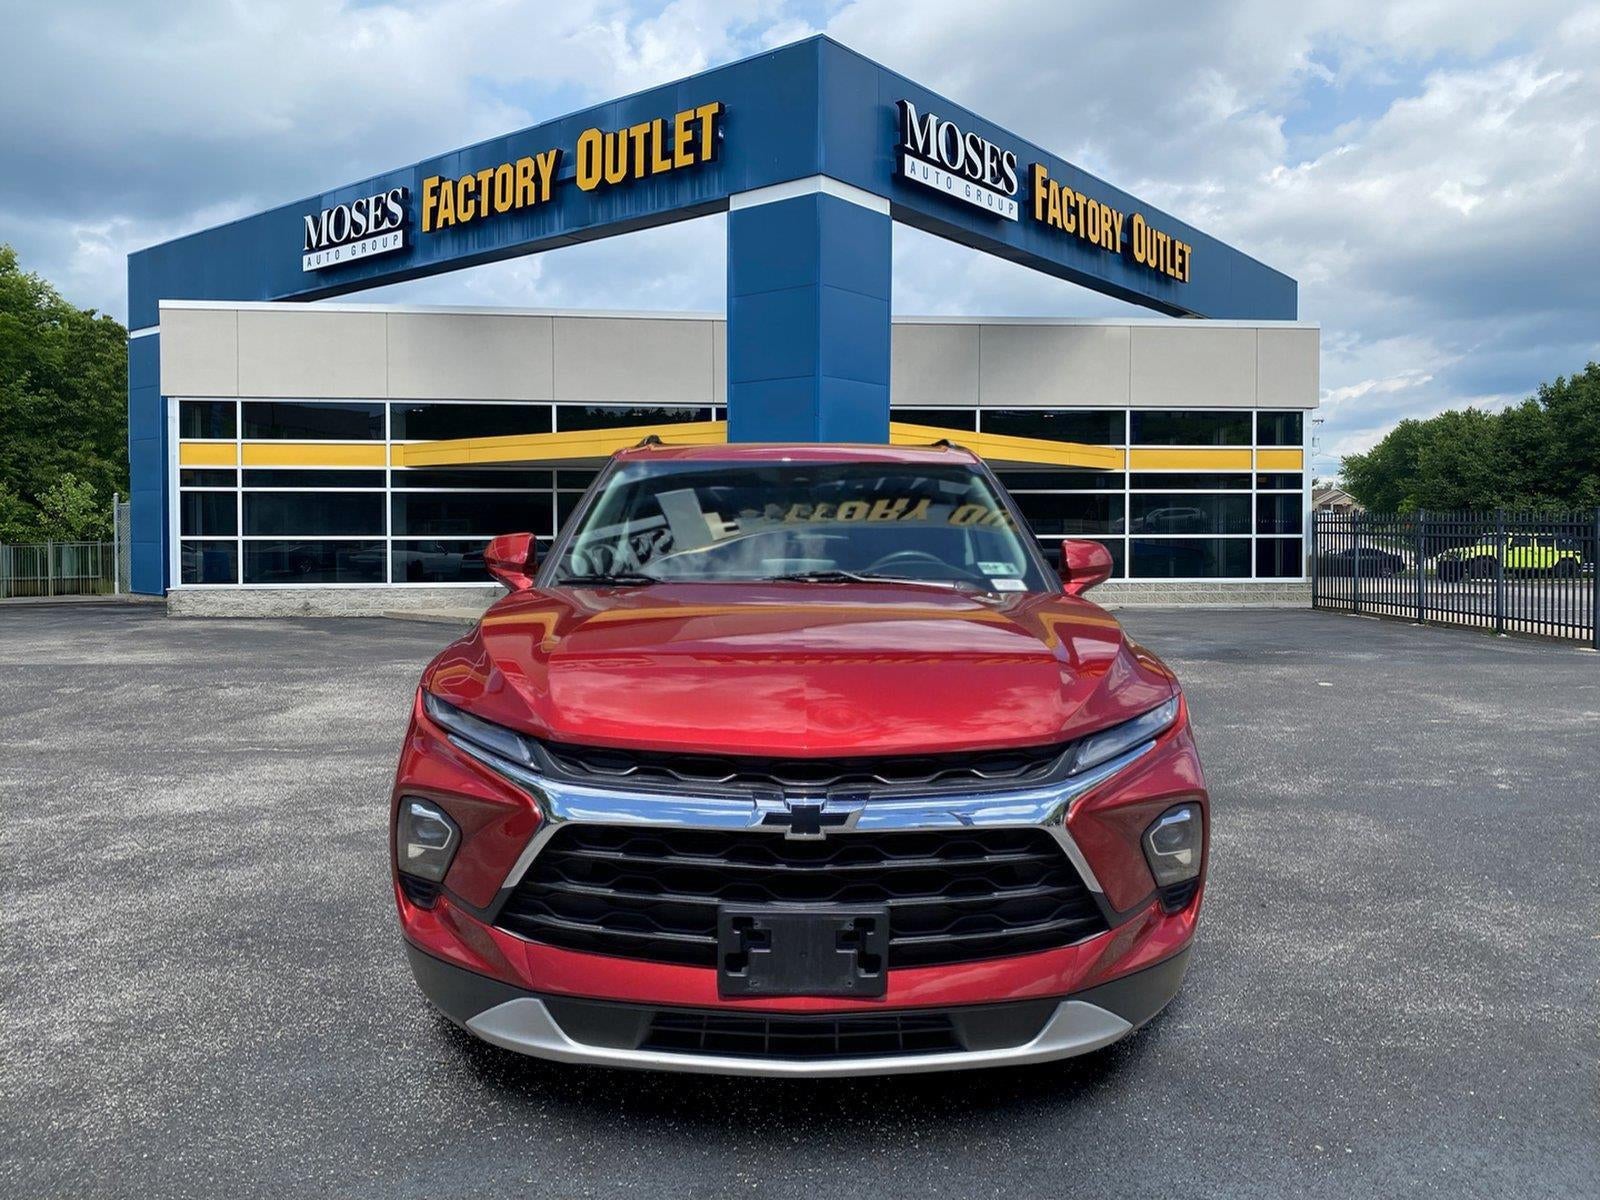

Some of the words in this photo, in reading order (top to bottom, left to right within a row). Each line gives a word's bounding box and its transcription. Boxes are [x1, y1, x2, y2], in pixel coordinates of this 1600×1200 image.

[422, 149, 558, 233] FACTORY
[576, 101, 721, 192] OUTLET
[904, 100, 1018, 196] MOSES
[303, 186, 404, 251] MOSES
[909, 163, 953, 190] AUTO
[964, 185, 1014, 215] GROUP
[1035, 163, 1123, 254] FACTORY
[1131, 212, 1192, 283] OUTLET
[307, 250, 340, 268] AUTO
[350, 234, 399, 256] GROUP
